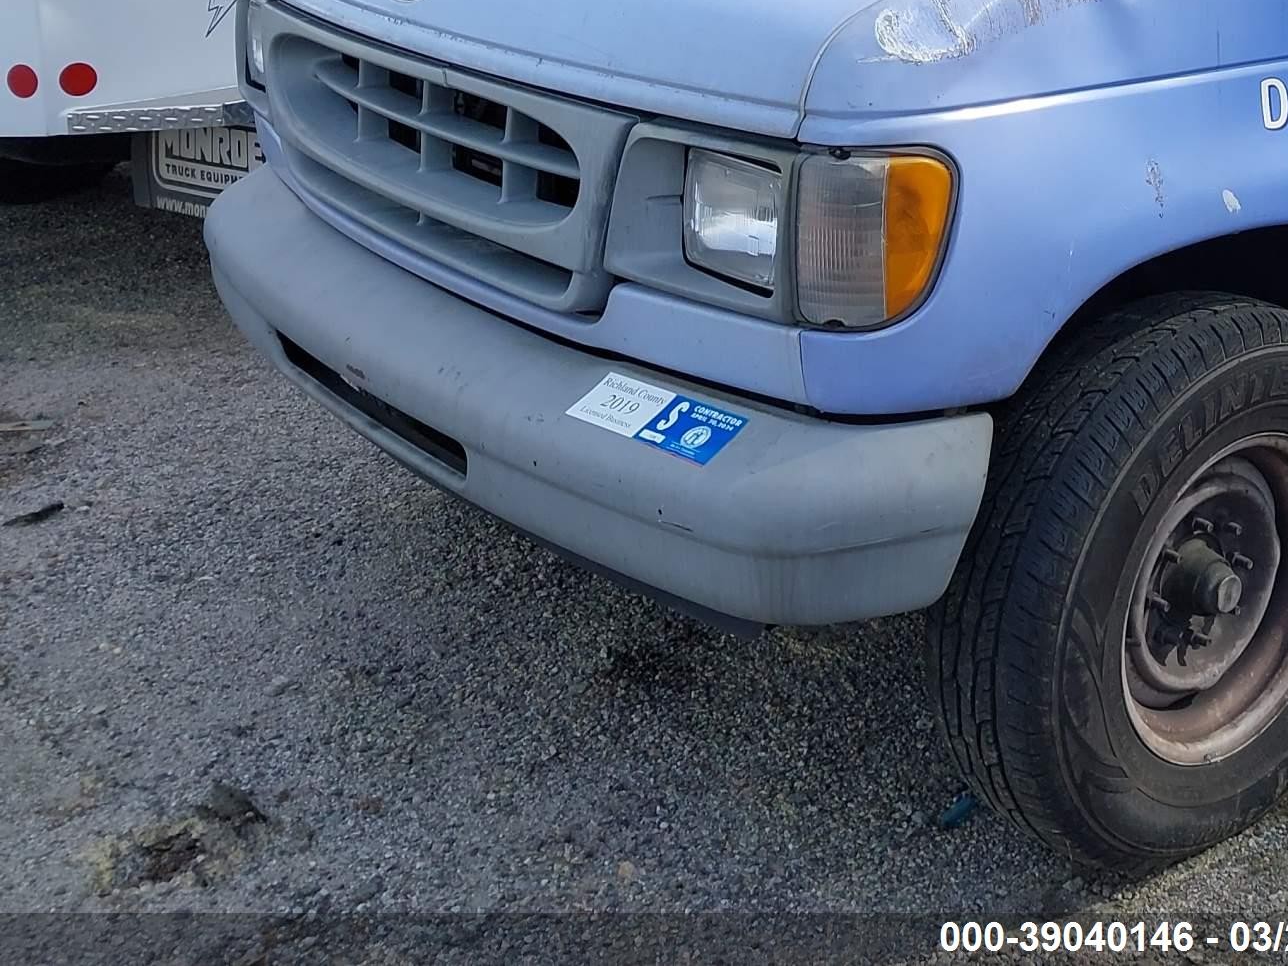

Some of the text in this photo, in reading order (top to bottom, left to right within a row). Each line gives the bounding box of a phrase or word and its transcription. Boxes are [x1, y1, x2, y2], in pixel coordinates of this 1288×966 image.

[165, 163, 244, 185] TRUCK EQUIPM
[156, 195, 207, 218] www.mon
[603, 377, 666, 407] Richland County
[600, 394, 640, 415] 2019
[694, 405, 743, 427] CONTRACTOR
